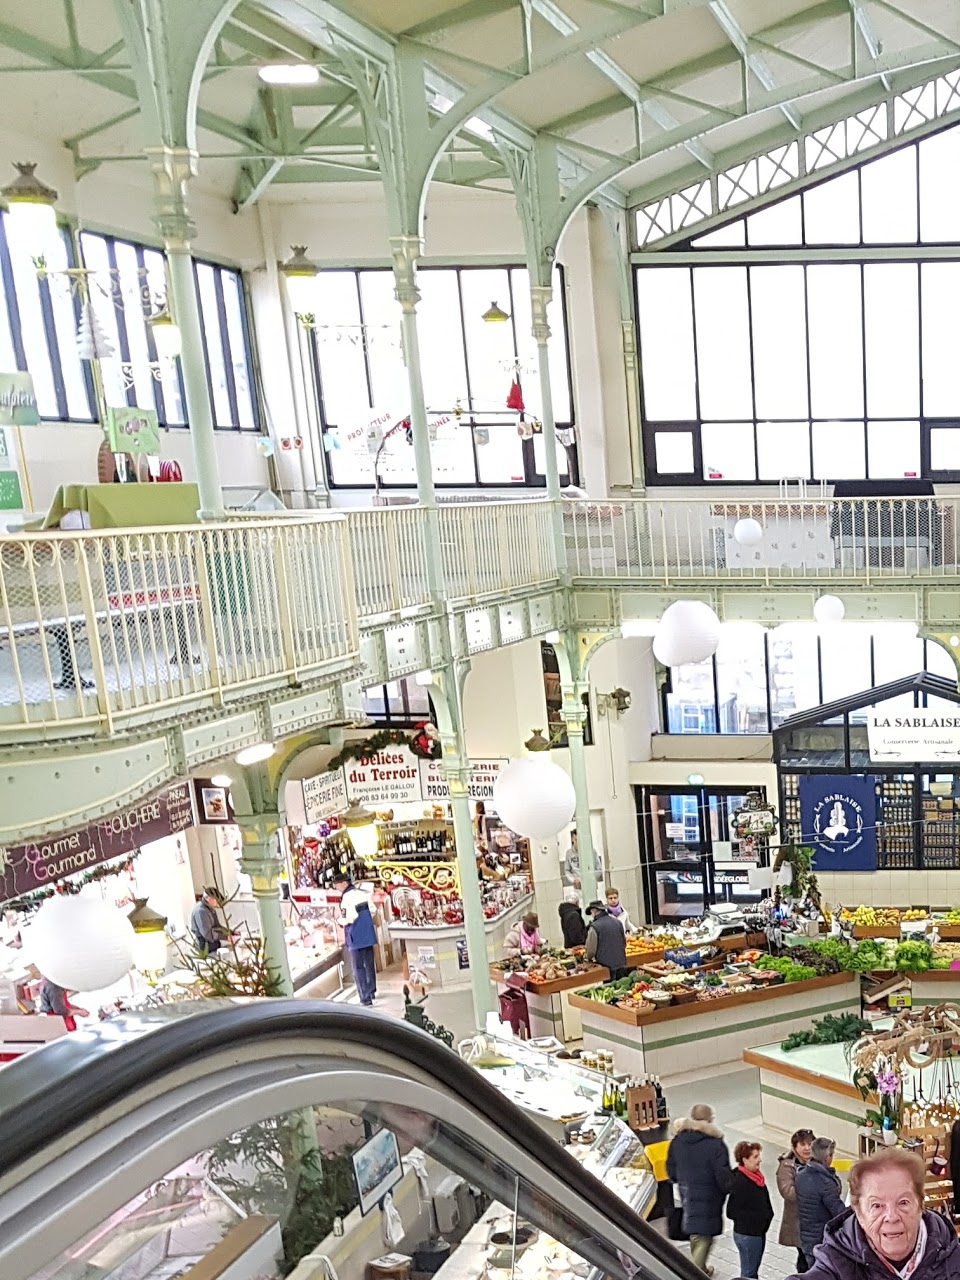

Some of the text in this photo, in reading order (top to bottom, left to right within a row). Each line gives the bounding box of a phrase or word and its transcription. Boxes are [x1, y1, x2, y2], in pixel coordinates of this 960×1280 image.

[873, 717, 960, 728] LA SABLAISE
[349, 765, 417, 783] du Terroir
[381, 784, 389, 792] LE
[823, 793, 863, 813] SABLAISE
[103, 800, 161, 837] BOUCHERIE
[25, 832, 81, 863] Gourmet
[33, 844, 97, 881] Gourmand
